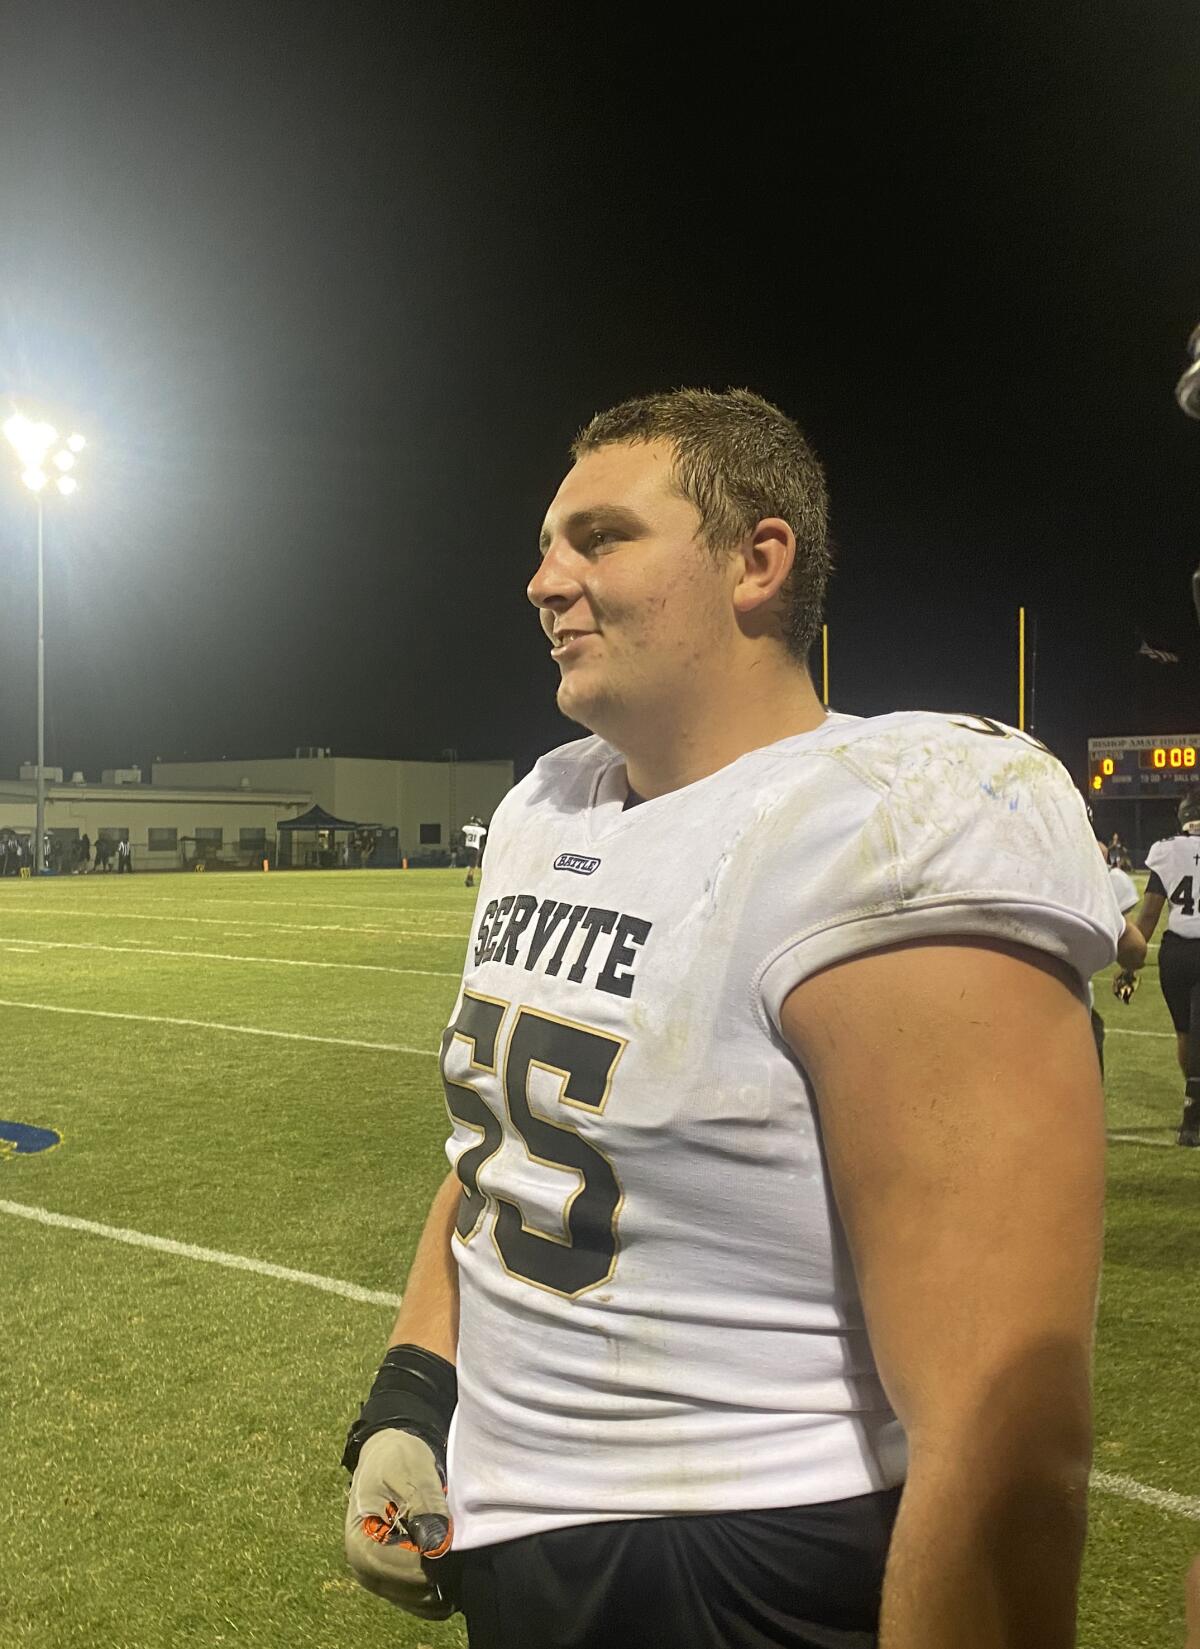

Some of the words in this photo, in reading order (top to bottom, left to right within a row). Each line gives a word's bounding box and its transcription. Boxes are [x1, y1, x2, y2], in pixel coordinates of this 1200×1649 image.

[1103, 758, 1114, 775] 0
[467, 834, 477, 843] 31
[557, 856, 597, 872] BATTLE
[1170, 875, 1200, 916] 4
[474, 894, 653, 999] SERVITE
